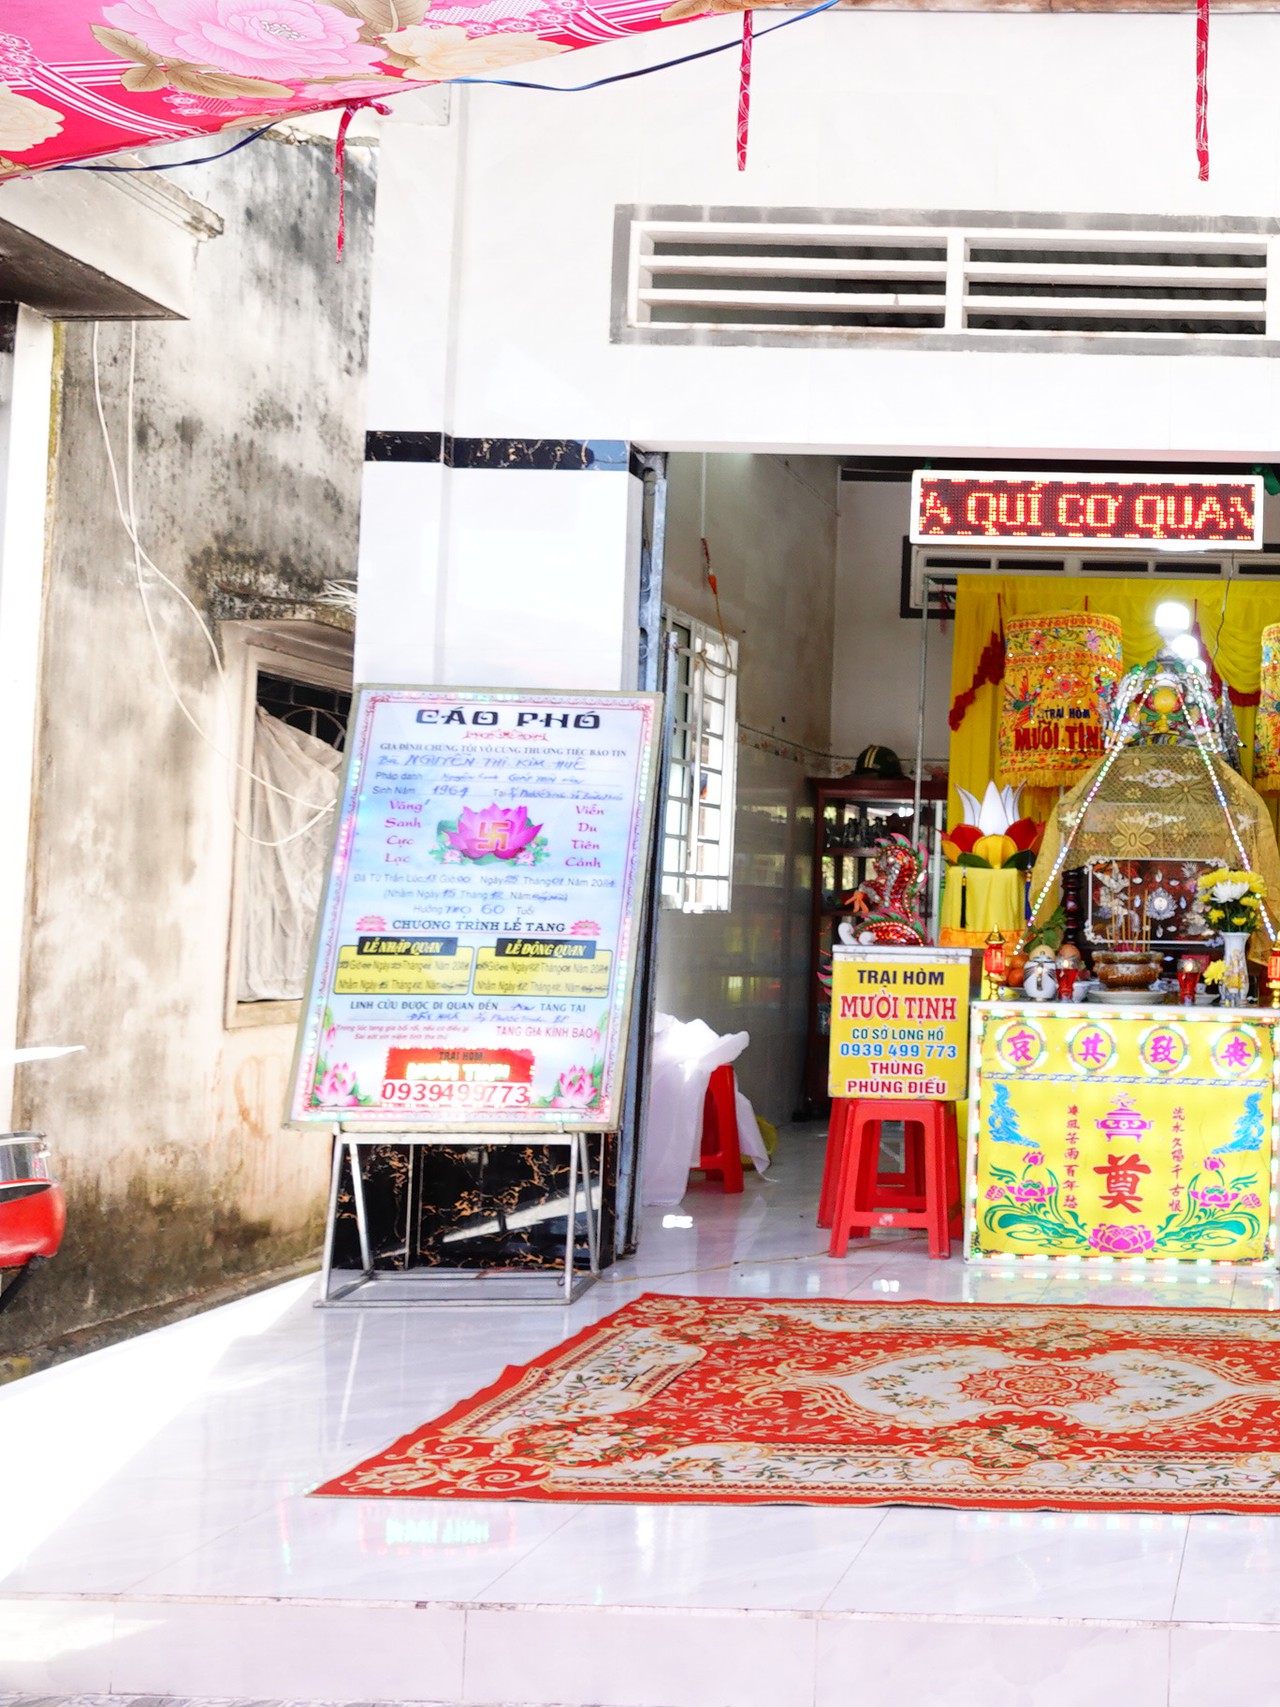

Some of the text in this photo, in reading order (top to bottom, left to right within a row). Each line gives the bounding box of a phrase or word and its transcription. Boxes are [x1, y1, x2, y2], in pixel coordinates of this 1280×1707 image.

[1059, 494, 1123, 526] CƠ
[416, 706, 600, 729] CÁO PHÓ
[381, 743, 396, 751] GIA
[385, 817, 421, 828] Sanh
[578, 822, 597, 832] Du
[526, 922, 566, 932] TANG
[857, 968, 944, 988] TRẠI HÒM
[350, 1001, 373, 1009] LINH
[446, 1002, 475, 1011] QUAN
[840, 990, 957, 1025] MƯỜI TỊNH
[497, 1026, 521, 1036] TANG
[525, 1026, 541, 1036] GIA
[852, 1028, 869, 1040] CƠ
[892, 1029, 924, 1040] LONG
[840, 1043, 957, 1058] 0939 499 773
[870, 1060, 924, 1075] THÙNG
[381, 1082, 531, 1104] 0939499773
[907, 1078, 946, 1094] ĐIẾU
[1093, 1153, 1151, 1213] 奠
